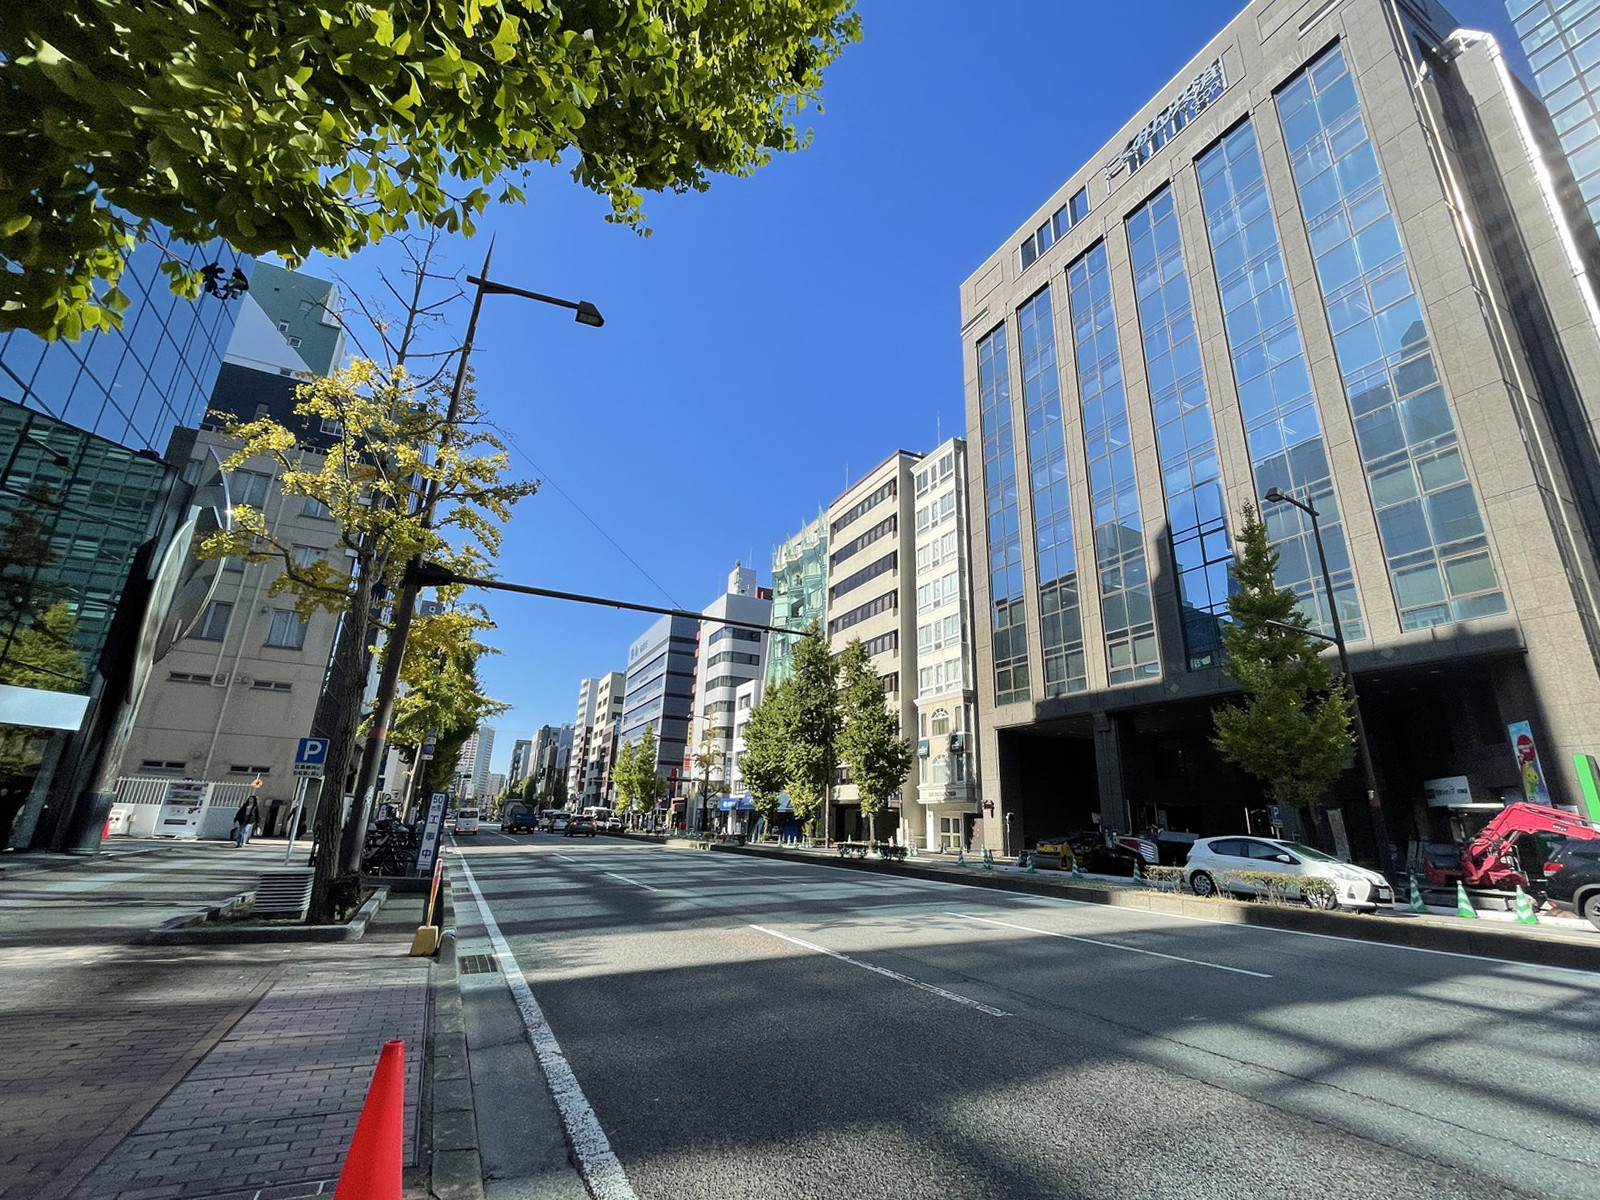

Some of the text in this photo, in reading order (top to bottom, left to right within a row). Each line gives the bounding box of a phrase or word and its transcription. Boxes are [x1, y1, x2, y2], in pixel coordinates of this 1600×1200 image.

[1105, 59, 1220, 177] こくみん共済
[303, 740, 322, 761] P
[433, 795, 444, 804] 50
[421, 814, 439, 859] 工事中
